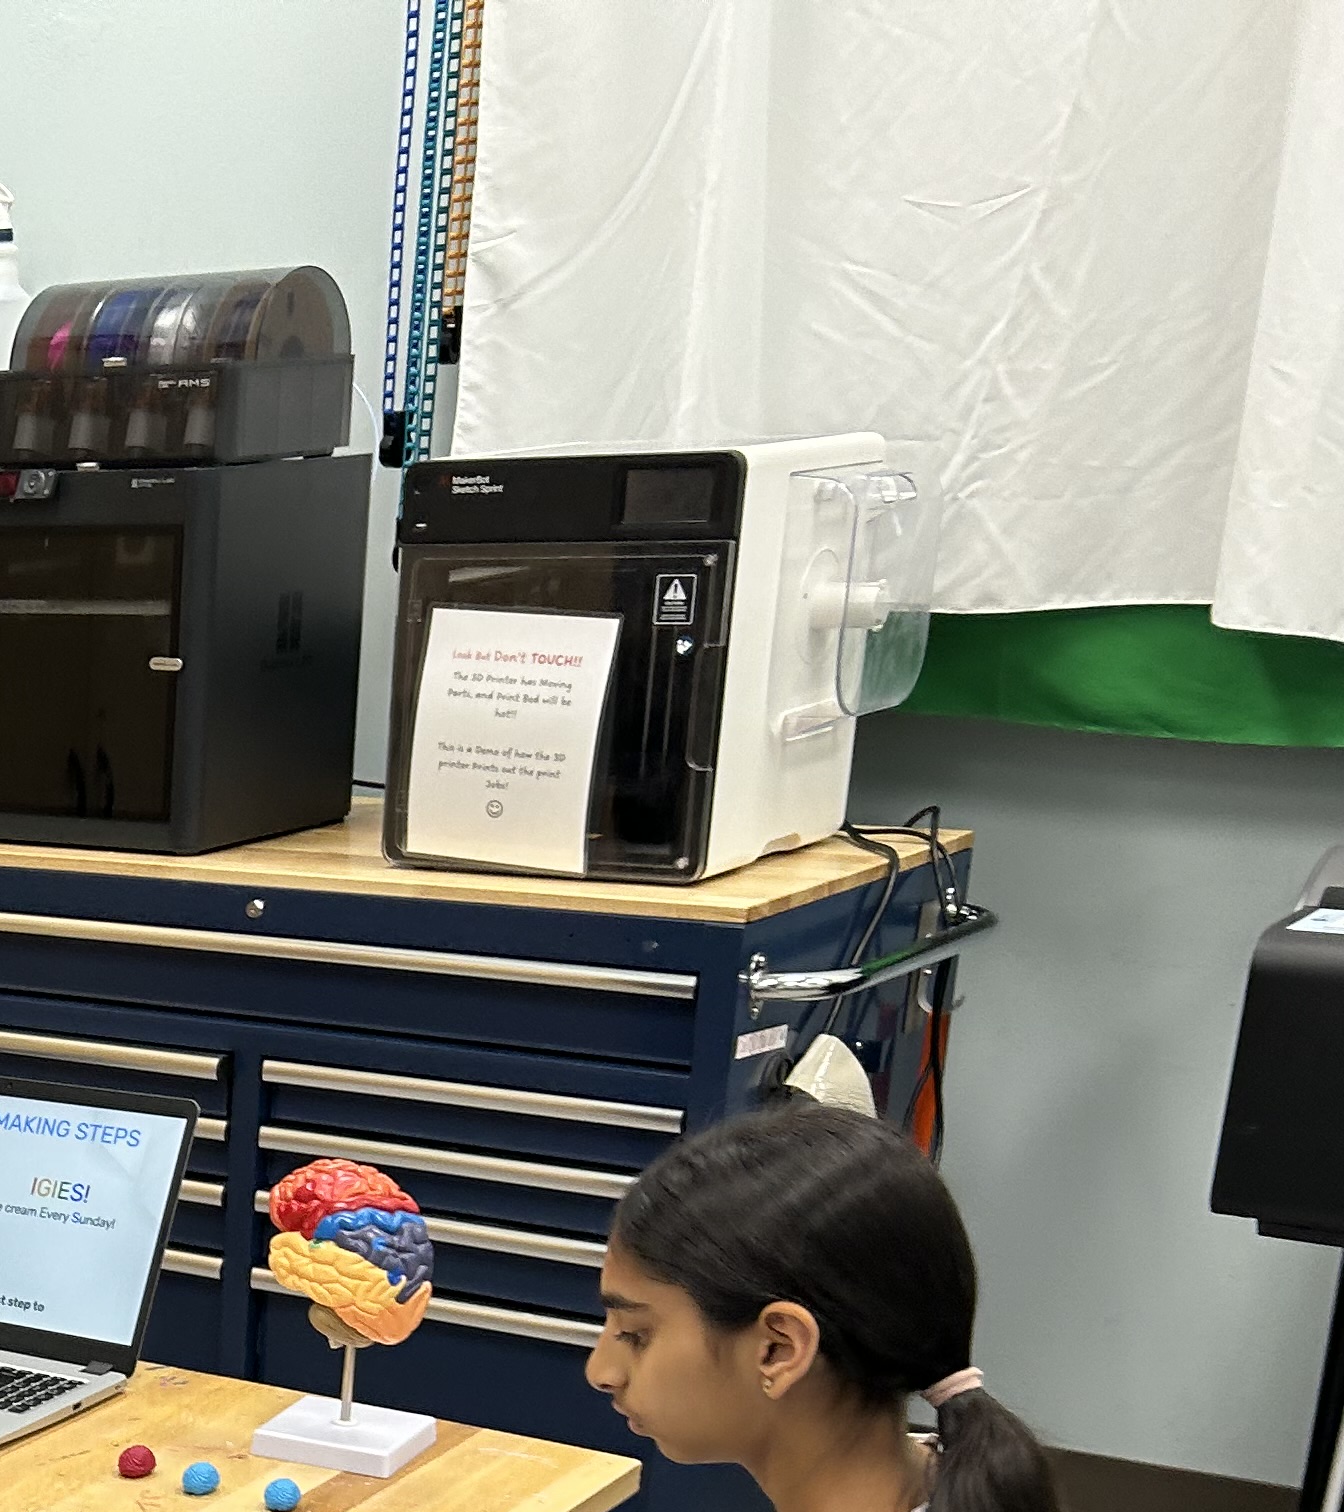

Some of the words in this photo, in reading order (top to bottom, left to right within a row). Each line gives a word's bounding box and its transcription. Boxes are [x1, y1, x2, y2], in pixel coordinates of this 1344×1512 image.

[494, 650, 526, 664] Don't
[531, 652, 583, 667] TOUCH!!
[74, 1122, 142, 1148] STEPS
[30, 1177, 91, 1203] IGIES!
[4, 1204, 38, 1218] cream
[39, 1206, 70, 1224] Every
[71, 1212, 116, 1231] Sunday!
[7, 1296, 32, 1311] step
[33, 1300, 45, 1312] to
